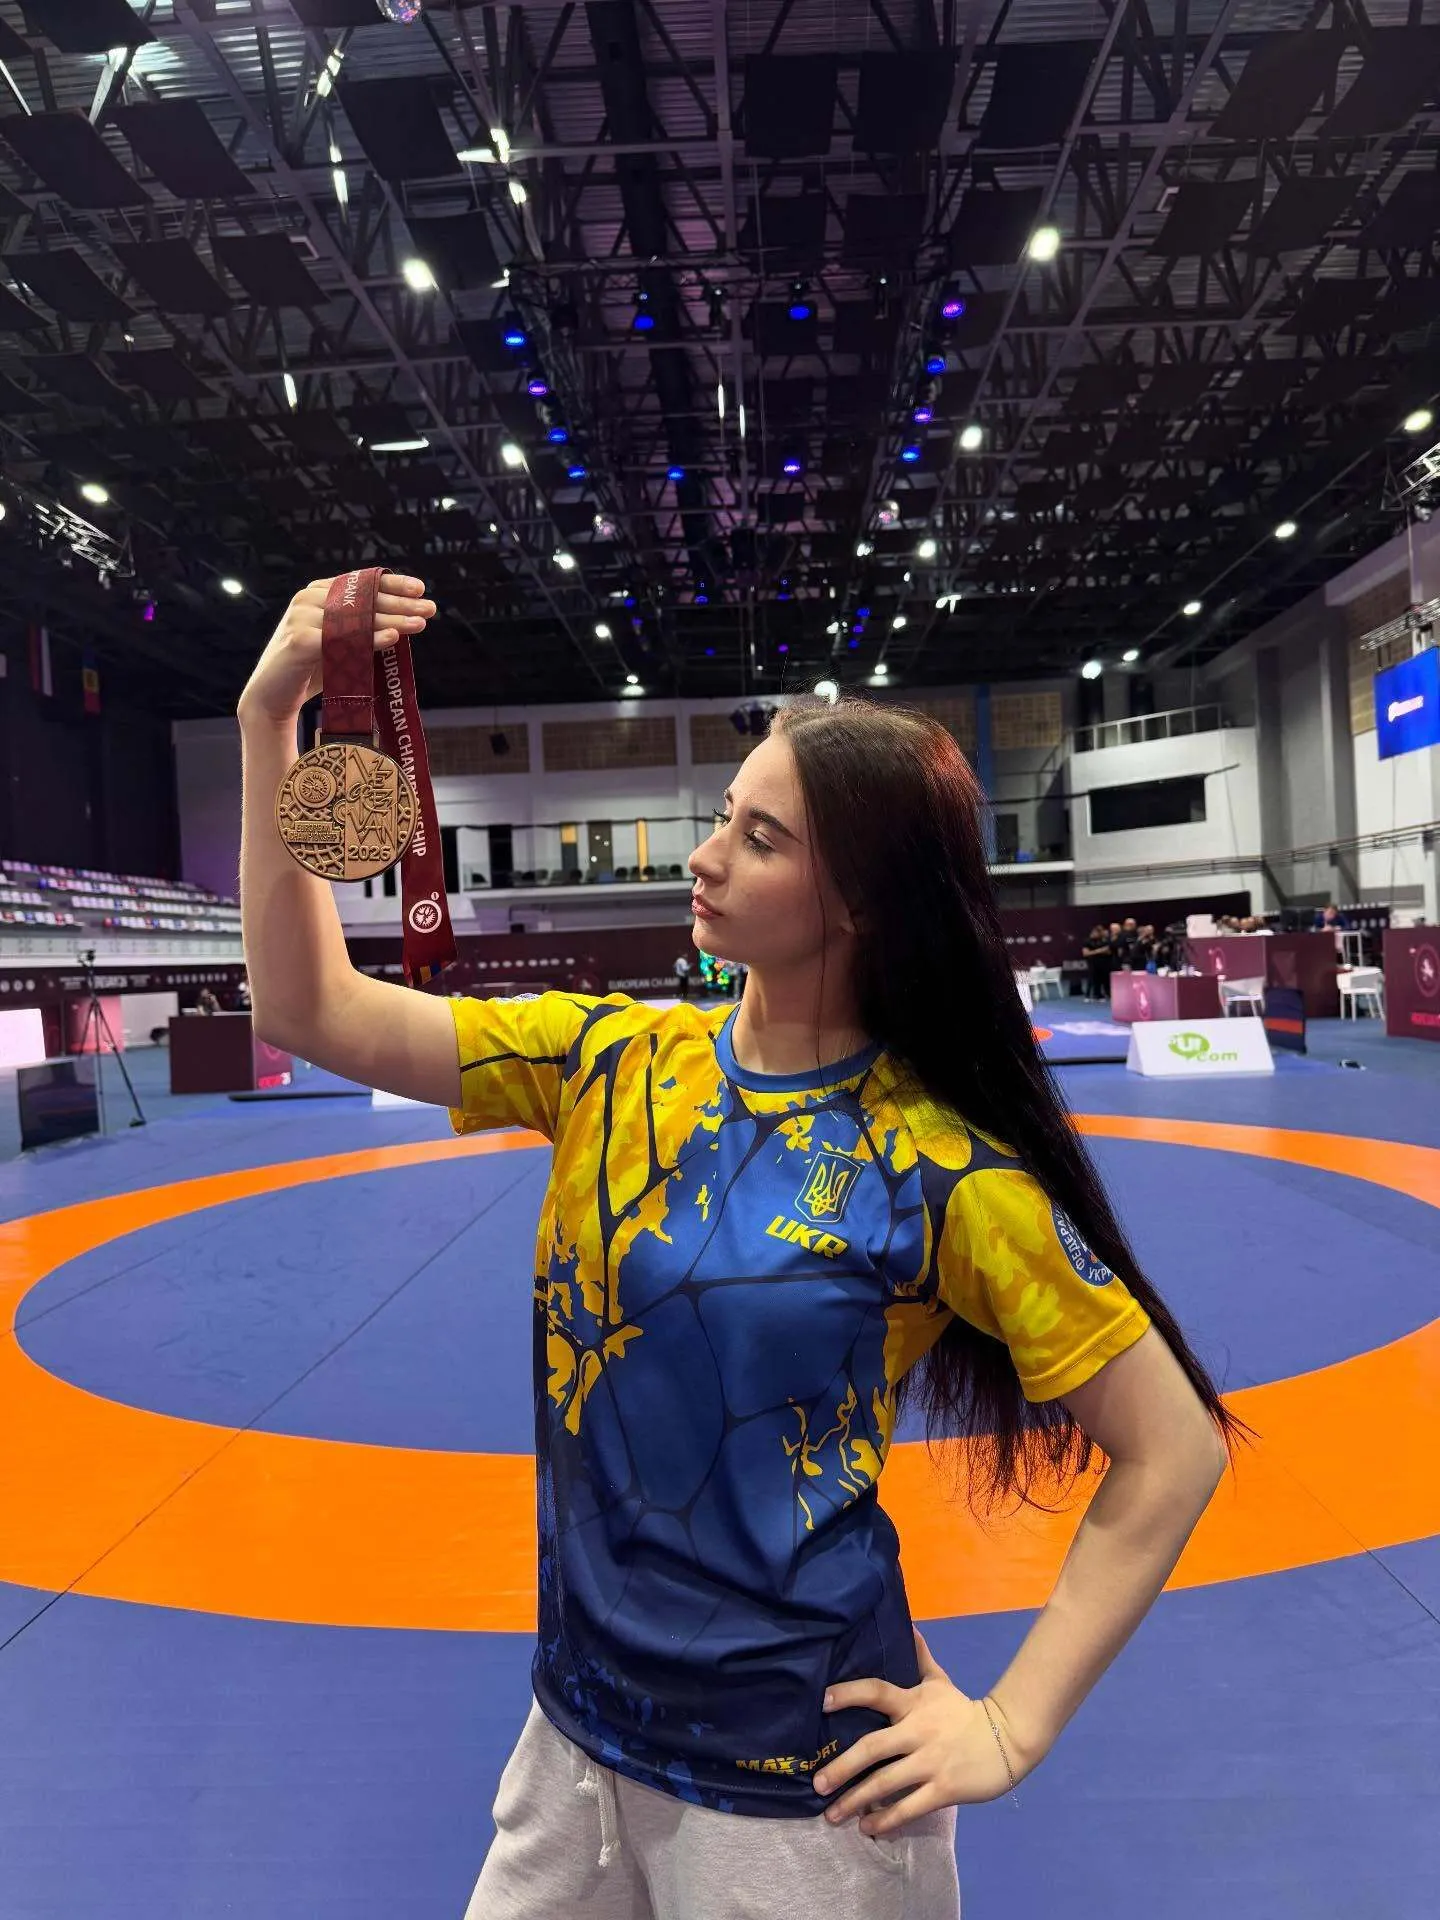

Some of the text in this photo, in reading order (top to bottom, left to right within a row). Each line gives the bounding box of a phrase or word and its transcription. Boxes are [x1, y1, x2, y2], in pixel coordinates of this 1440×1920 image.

[381, 645, 409, 733] EUROPEAN
[347, 845, 392, 862] 2026
[765, 1215, 848, 1259] UKR
